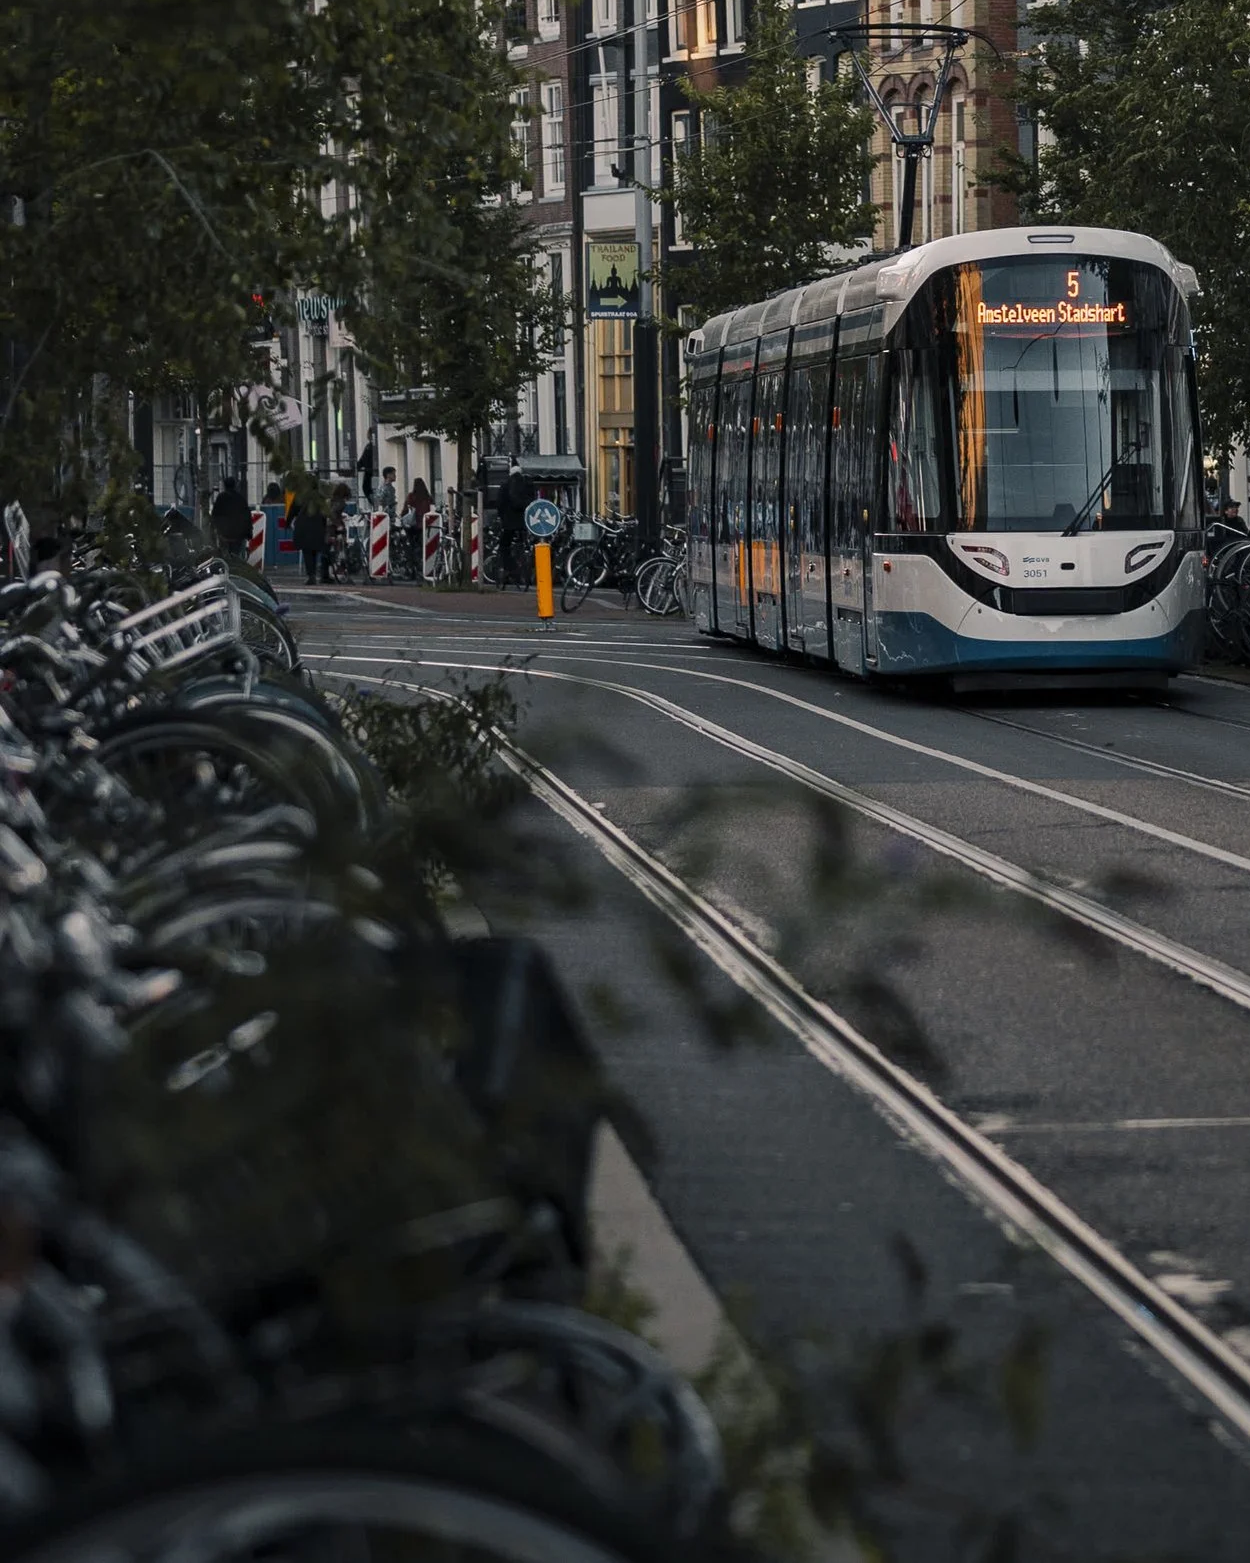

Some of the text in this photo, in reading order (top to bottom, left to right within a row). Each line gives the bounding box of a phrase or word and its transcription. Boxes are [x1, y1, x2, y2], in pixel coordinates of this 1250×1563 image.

[591, 245, 636, 253] THAILAND
[601, 254, 626, 262] FOOD
[1067, 271, 1080, 298] 5
[977, 301, 1125, 324] Amstelveen Stadshart
[1023, 569, 1047, 578] 3051
